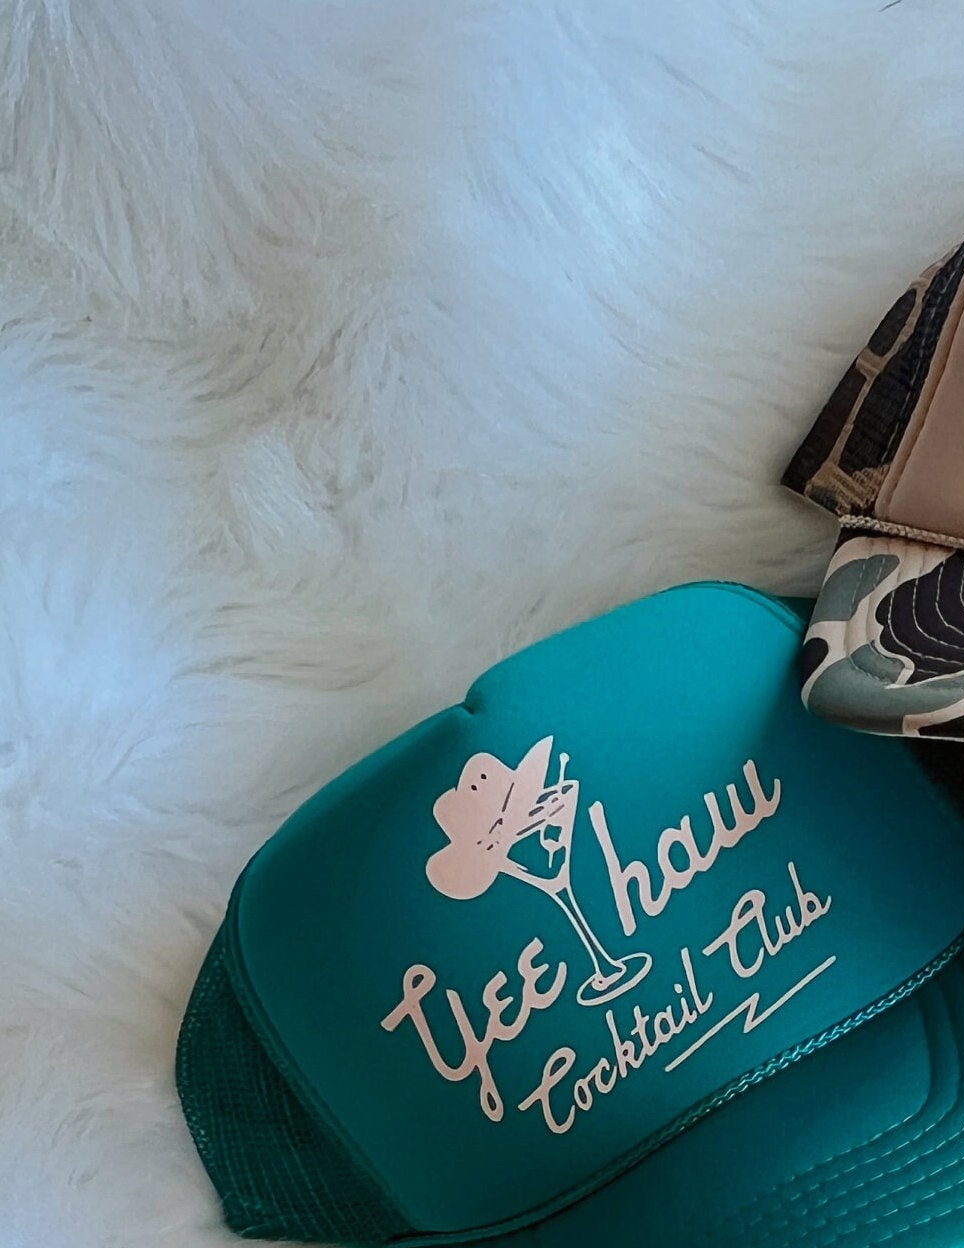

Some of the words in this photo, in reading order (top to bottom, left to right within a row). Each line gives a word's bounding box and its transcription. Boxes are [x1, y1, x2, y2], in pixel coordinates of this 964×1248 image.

[588, 759, 781, 937] haw
[517, 947, 714, 1134] Cocktail
[702, 861, 832, 978] Club
